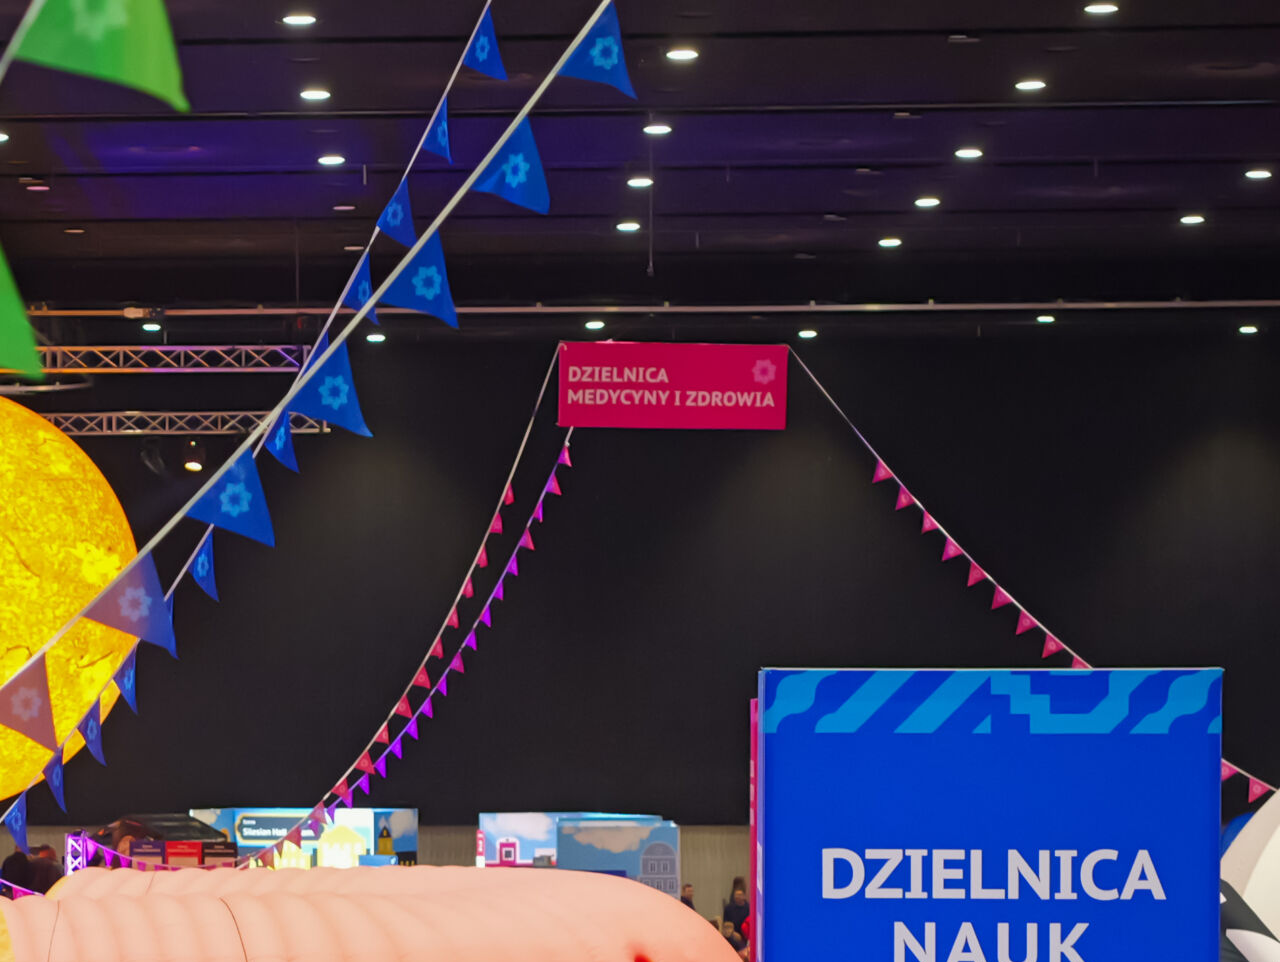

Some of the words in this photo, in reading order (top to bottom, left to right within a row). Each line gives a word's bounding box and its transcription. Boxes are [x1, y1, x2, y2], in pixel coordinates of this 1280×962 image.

[568, 366, 669, 383] DZIELNICA
[567, 389, 670, 405] MEDYCYNY
[674, 391, 681, 406] I
[684, 390, 775, 408] ZDROWIA
[821, 848, 1167, 901] DZIELNICA
